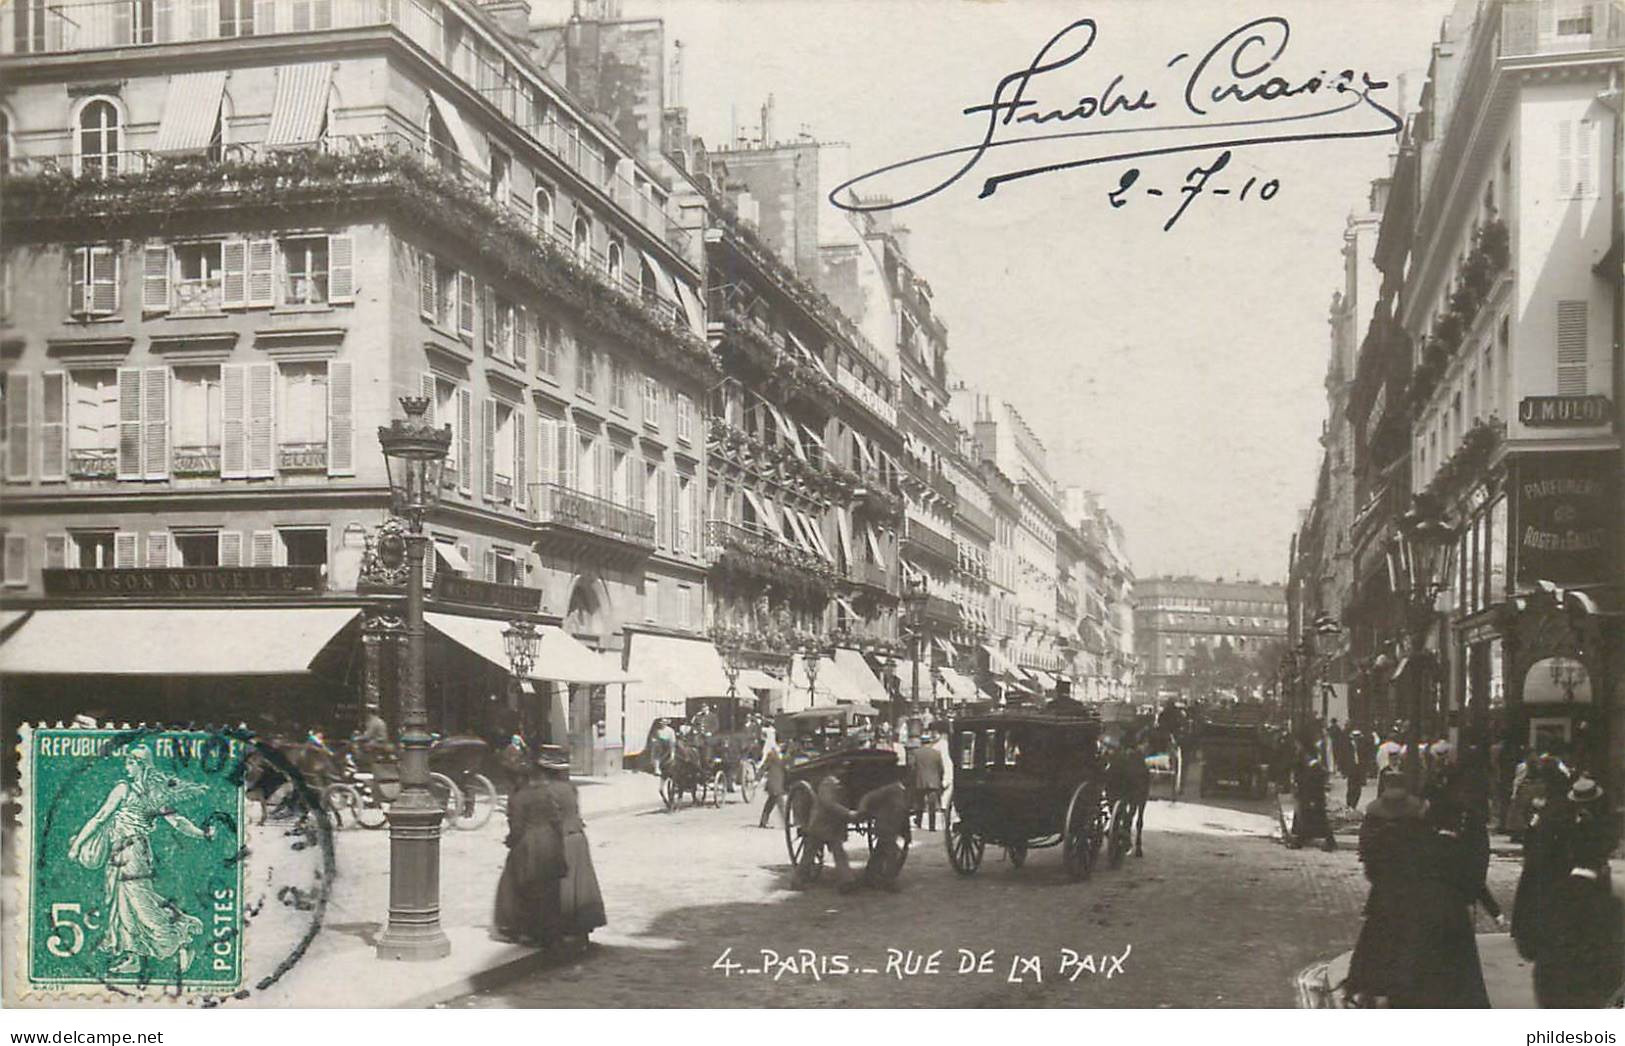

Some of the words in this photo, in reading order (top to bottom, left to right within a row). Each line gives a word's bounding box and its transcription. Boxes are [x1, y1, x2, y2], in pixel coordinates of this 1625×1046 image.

[1109, 151, 1279, 231] 2-7-10
[66, 573, 153, 591] MAISON
[167, 571, 294, 590] NOUVELLE
[213, 888, 234, 971] POSTES
